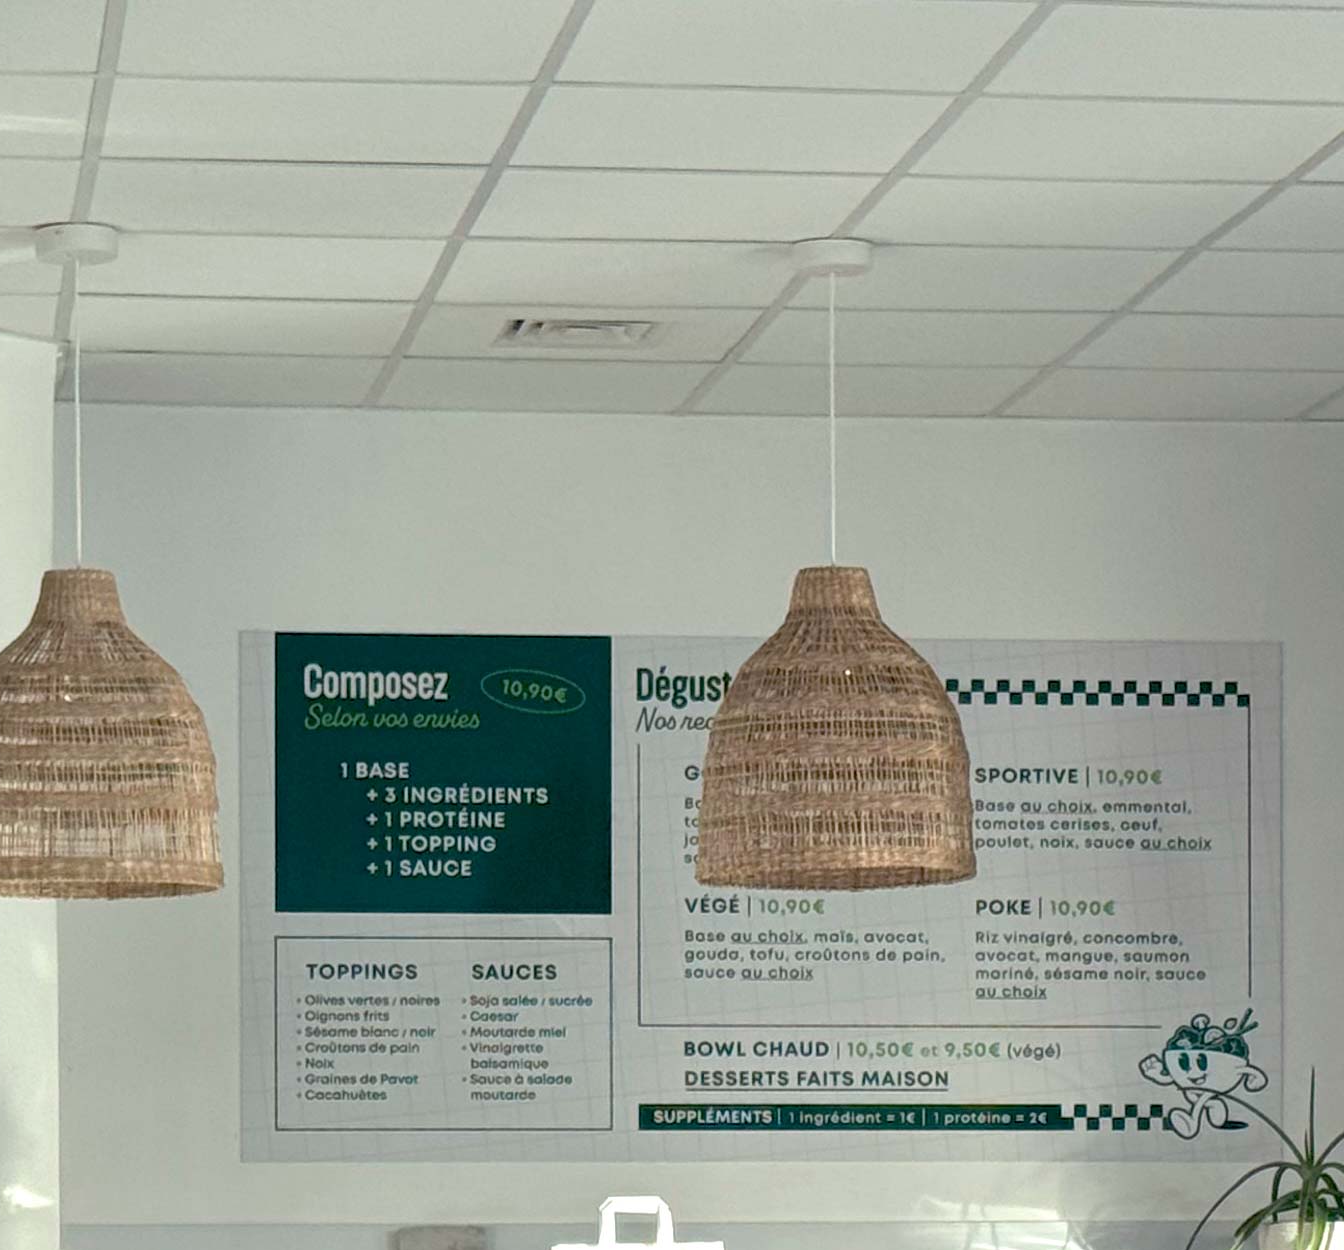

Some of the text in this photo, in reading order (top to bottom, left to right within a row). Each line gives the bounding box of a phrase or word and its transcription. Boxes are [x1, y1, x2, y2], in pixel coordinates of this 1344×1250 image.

[303, 662, 448, 706] Composez
[501, 679, 568, 704] 10,90€
[636, 665, 733, 709] Dégust
[304, 705, 481, 730] Selon vos envies
[635, 707, 677, 733] Nos
[340, 762, 410, 779] 1 BASE
[974, 767, 1079, 785] SPORTIVE
[1097, 769, 1163, 786] 10,90€
[385, 786, 397, 804] 3
[403, 783, 549, 804] INGRÉDIENTS
[975, 799, 1016, 813] Base
[1020, 802, 1041, 813] au
[385, 811, 392, 829] 1
[400, 807, 506, 829] PROTÉINE
[975, 818, 1045, 831] tomates
[1050, 818, 1115, 832] cerises,
[385, 835, 392, 853] 1
[399, 835, 496, 853] TOPPING
[975, 836, 1034, 850] poulet,
[1084, 838, 1135, 849] sauce
[1140, 838, 1162, 850] au
[1167, 836, 1212, 850] choix
[385, 859, 392, 877] 1
[399, 859, 472, 877] SAUCE
[684, 894, 741, 914] VÉGÉ
[759, 898, 826, 916] 10,90€
[976, 899, 1032, 915] POKE
[1051, 900, 1116, 917] 10,90€
[684, 930, 726, 943] Base
[731, 932, 753, 943] au
[864, 931, 929, 945] avocat,
[975, 931, 1183, 947] Riz vinaigré, concombre,
[684, 947, 947, 964] gouda, tofu, croûtons de pain,
[975, 951, 1190, 965] avocat, mangue, saumon
[305, 963, 418, 980] TOPPINGS
[472, 963, 558, 980] SAUCES
[684, 966, 814, 980] sauce au choix
[975, 967, 1207, 982] mariné, sésame noir, sauce
[304, 993, 345, 1006] Olives
[348, 995, 390, 1006] vertes
[399, 994, 441, 1006] noires
[975, 985, 1047, 1000] au choix
[469, 994, 499, 1009] Soja
[502, 993, 538, 1006] salée
[548, 993, 593, 1006] sucrée
[304, 1008, 390, 1024] Oignons frits
[469, 1011, 519, 1022] Caesar
[304, 1025, 358, 1038] Sésame
[361, 1025, 399, 1038] blanc
[409, 1026, 437, 1038] noir
[469, 1025, 567, 1038] Moutarde miel
[304, 1040, 420, 1056] Croûtons de pain
[469, 1042, 544, 1056] Vinaigrette
[683, 1041, 746, 1058] BOWL
[752, 1041, 830, 1058] CHAUD
[847, 1042, 915, 1060] 10,50€
[920, 1044, 938, 1058] et
[943, 1042, 1001, 1060] 9,50€
[1007, 1042, 1063, 1061] (végé)
[304, 1057, 335, 1069] Noix
[470, 1057, 549, 1071] balsamique
[304, 1072, 419, 1085] Graines de Pavot
[469, 1073, 512, 1085] Sauce
[527, 1072, 573, 1085] salade
[684, 1070, 949, 1087] DESSERTS FAITS MAISON
[470, 1089, 536, 1101] moutarde
[653, 1106, 773, 1125] SUPPLÉMENTS
[789, 1111, 795, 1123] 1
[799, 1110, 882, 1127] ingrédient
[900, 1111, 916, 1125] 1€
[934, 1112, 939, 1124] 1
[943, 1110, 1012, 1127] protéine
[1029, 1112, 1048, 1125] 2€
